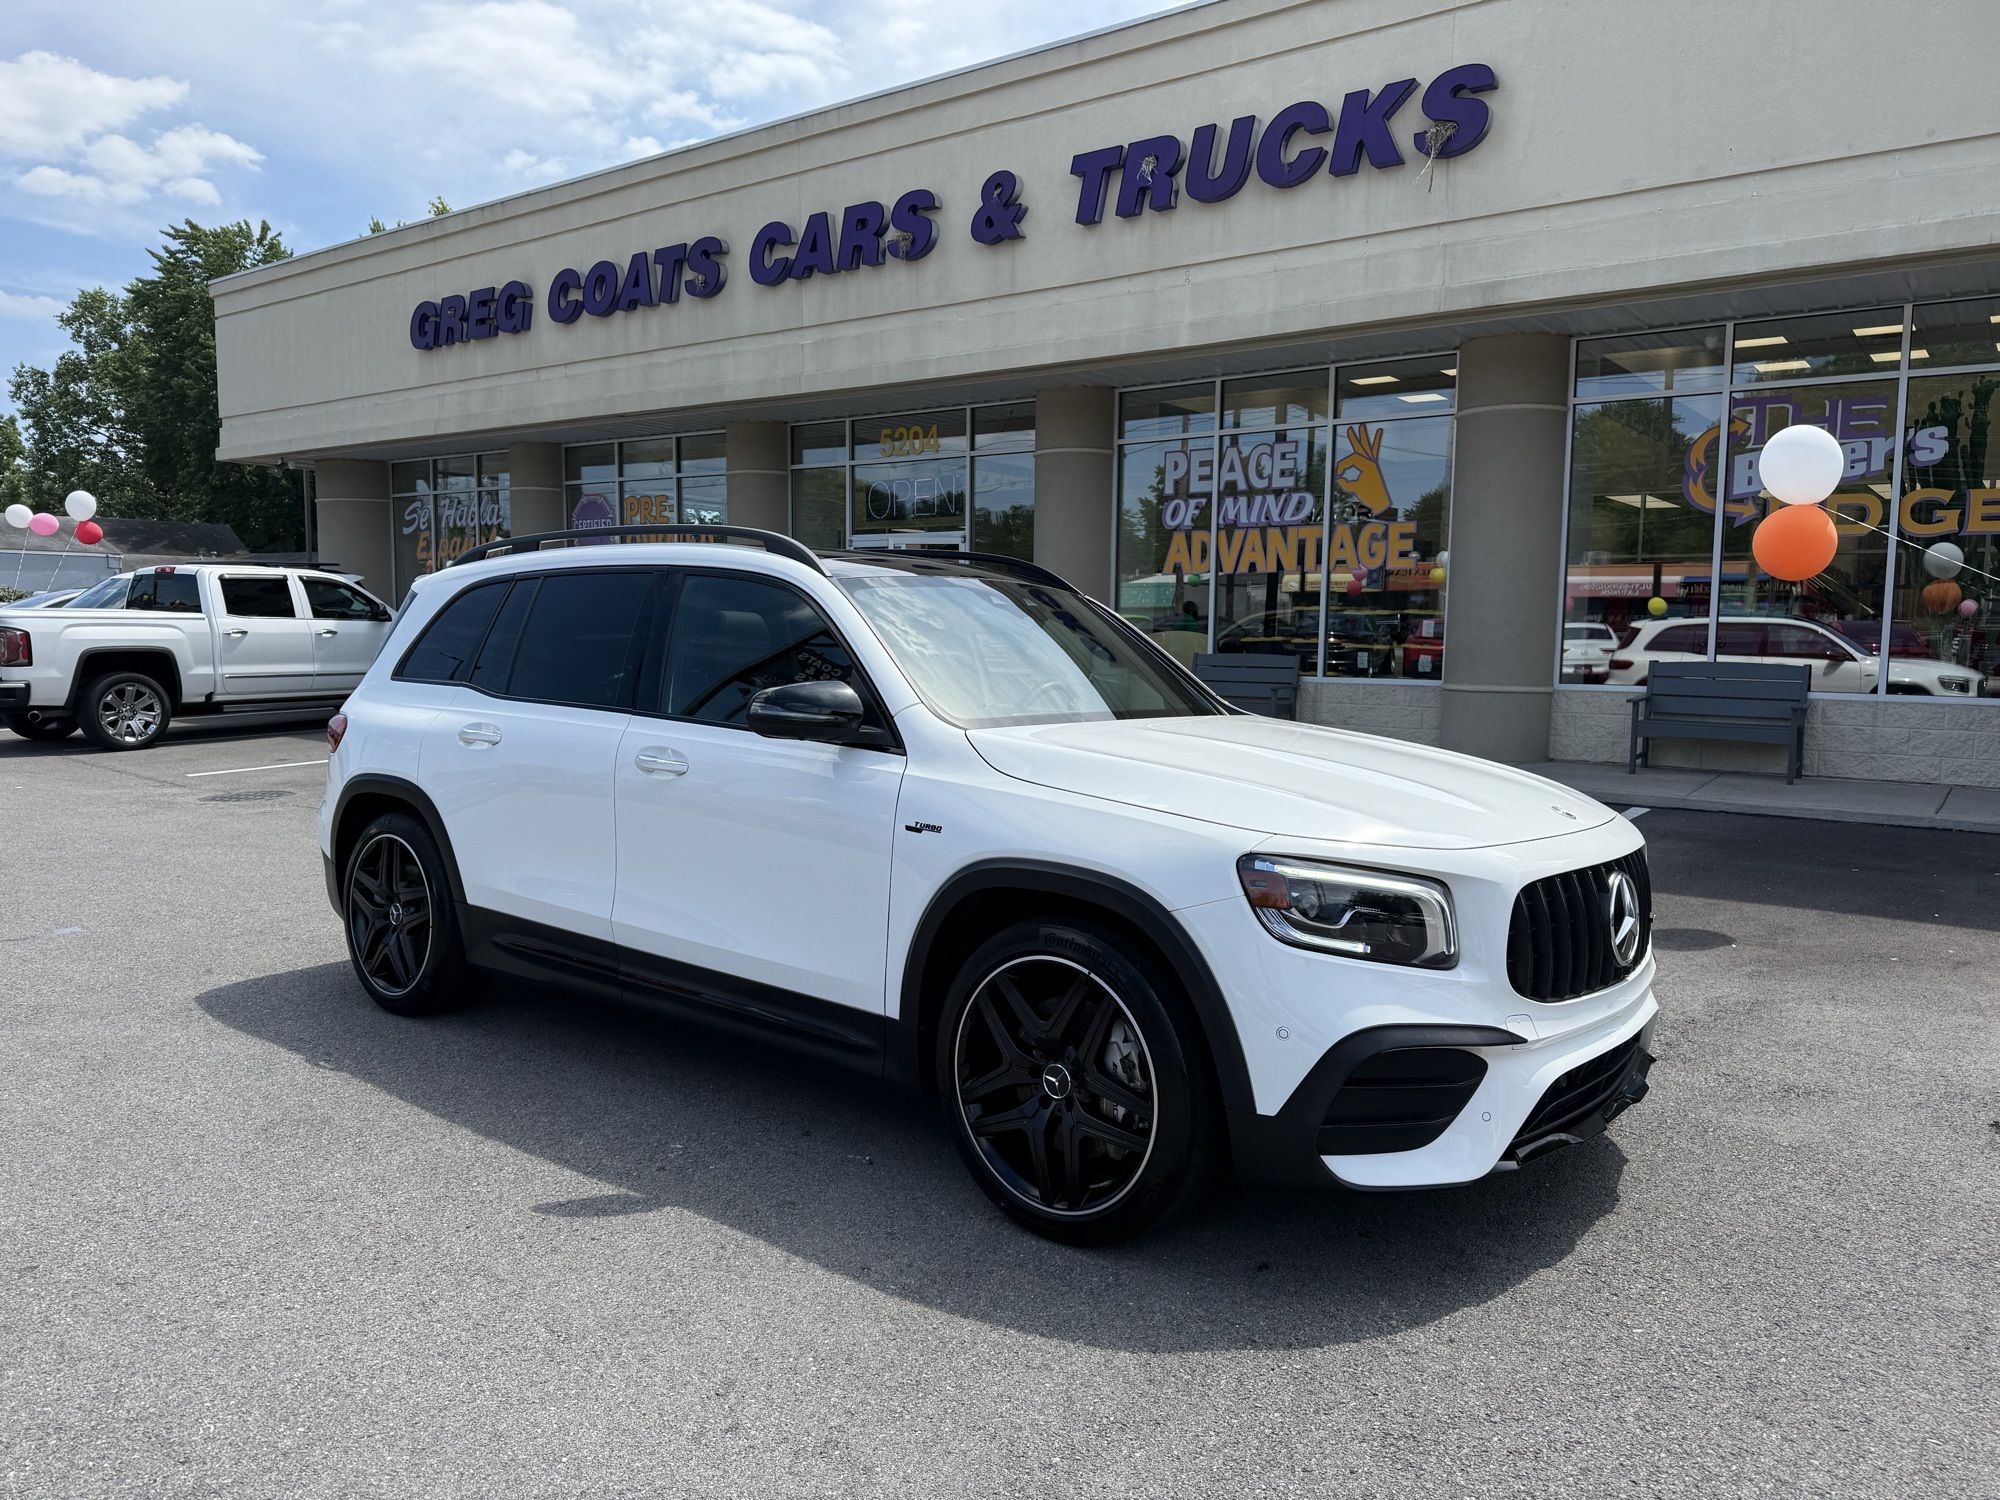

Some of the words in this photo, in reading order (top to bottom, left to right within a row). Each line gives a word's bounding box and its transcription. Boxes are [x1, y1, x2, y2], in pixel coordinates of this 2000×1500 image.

[410, 280, 534, 351] GREG
[548, 236, 730, 325] COATS
[749, 190, 942, 287] CARS
[970, 169, 1027, 245] &
[1070, 63, 1499, 226] TRUCKS
[880, 424, 940, 458] 5204
[1731, 394, 1889, 449] THE
[1163, 440, 1299, 496] PEACE
[1729, 426, 1949, 500] Ber's
[402, 501, 429, 535] Se
[440, 493, 503, 528] Habla
[625, 495, 675, 525] PRE-
[868, 475, 956, 519] OPEN
[1162, 498, 1206, 529] OF
[1218, 491, 1315, 526] MIND
[1765, 488, 2000, 537] DGE
[1161, 521, 1418, 575] ADVANTAGE
[914, 821, 943, 832] TURBO
